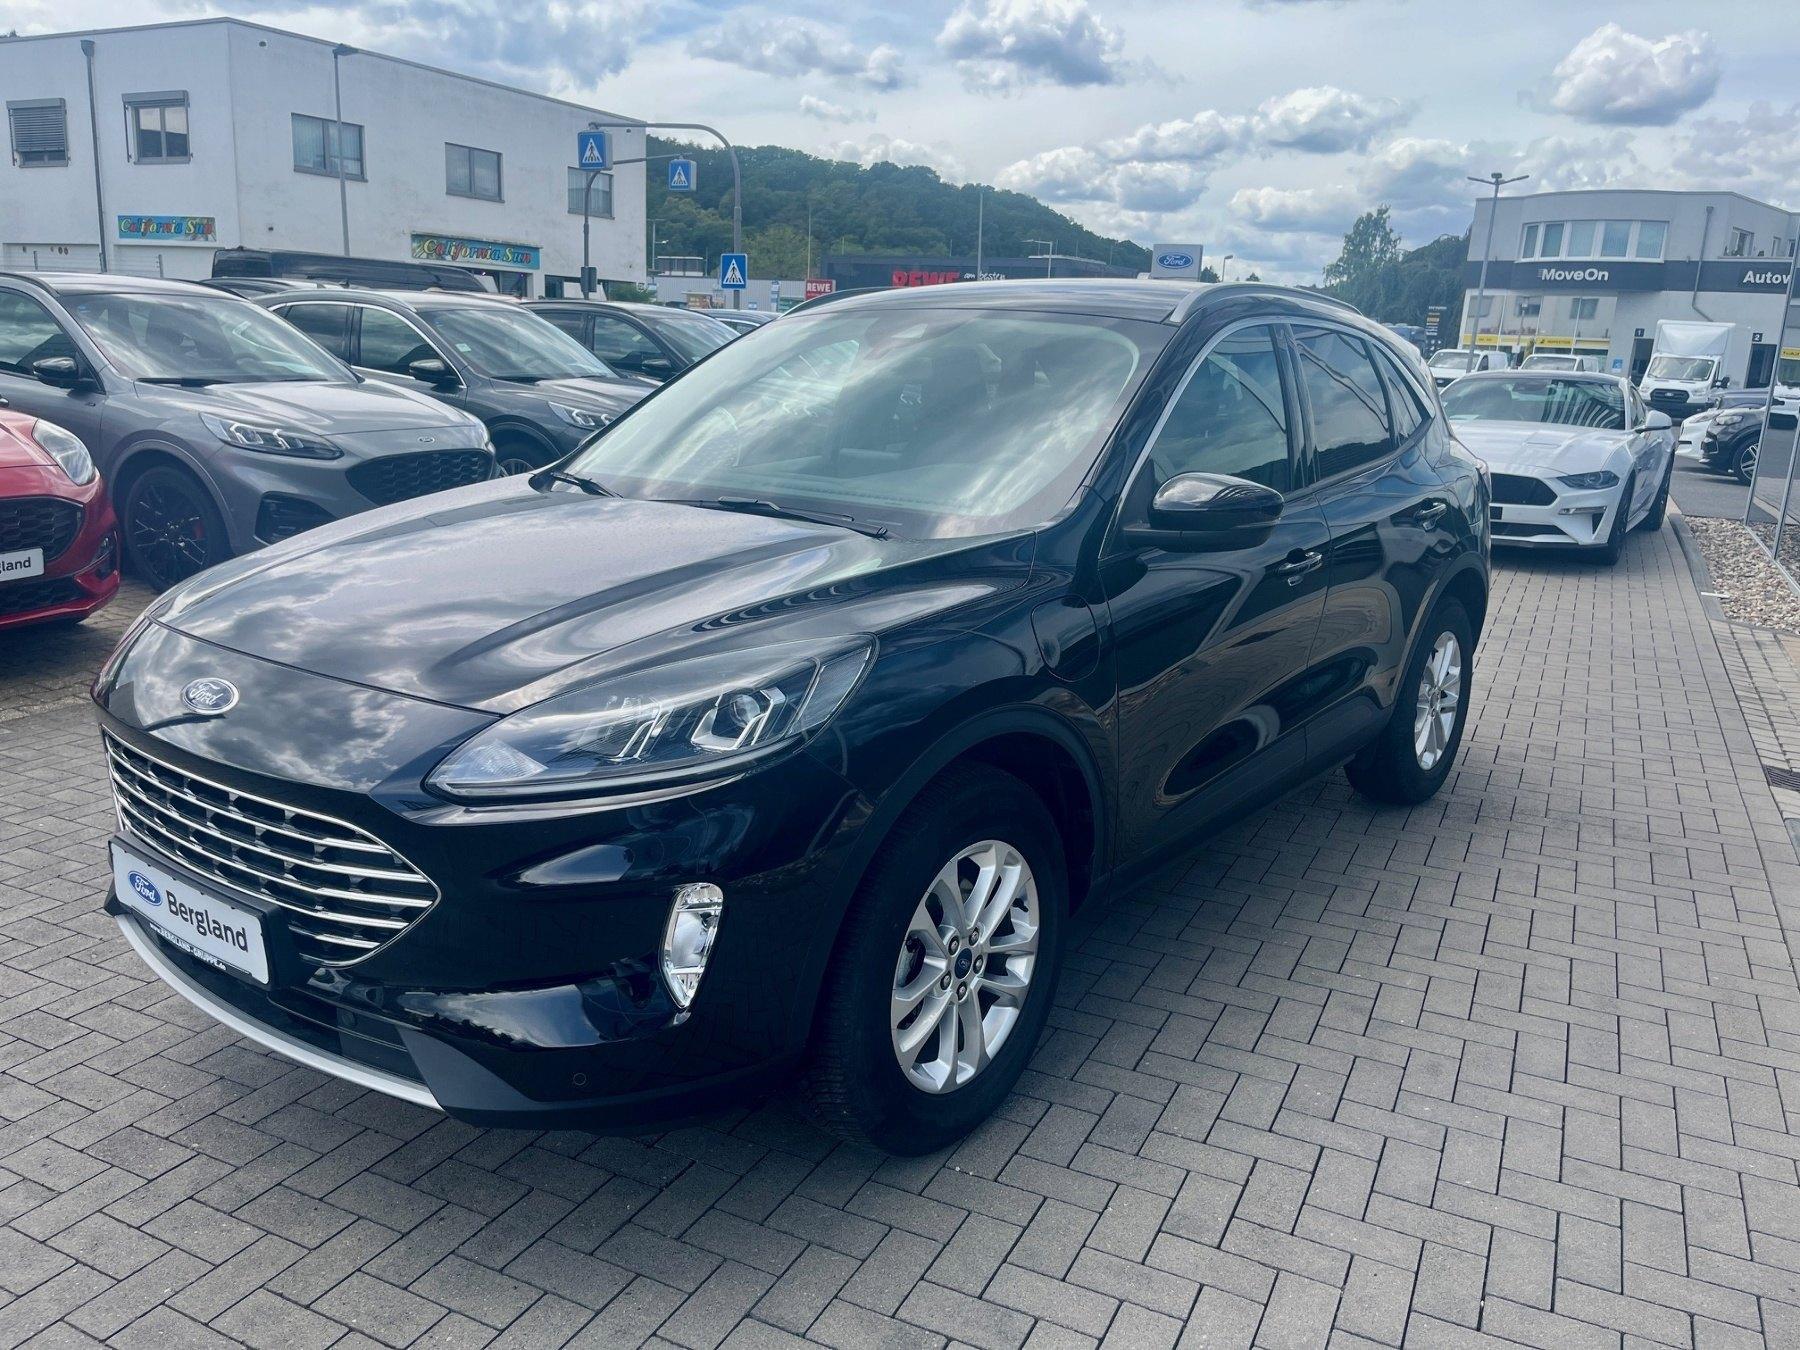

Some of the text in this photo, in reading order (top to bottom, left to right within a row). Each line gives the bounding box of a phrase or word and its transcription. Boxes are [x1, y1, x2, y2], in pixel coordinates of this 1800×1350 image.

[121, 219, 213, 237] California Sun
[424, 239, 531, 264] California Sun
[1541, 268, 1609, 281] MoveOn
[806, 282, 831, 293] REWE
[0, 556, 31, 574] land
[190, 682, 224, 706] Ford
[134, 875, 156, 902] Ford
[165, 889, 249, 953] Bergland
